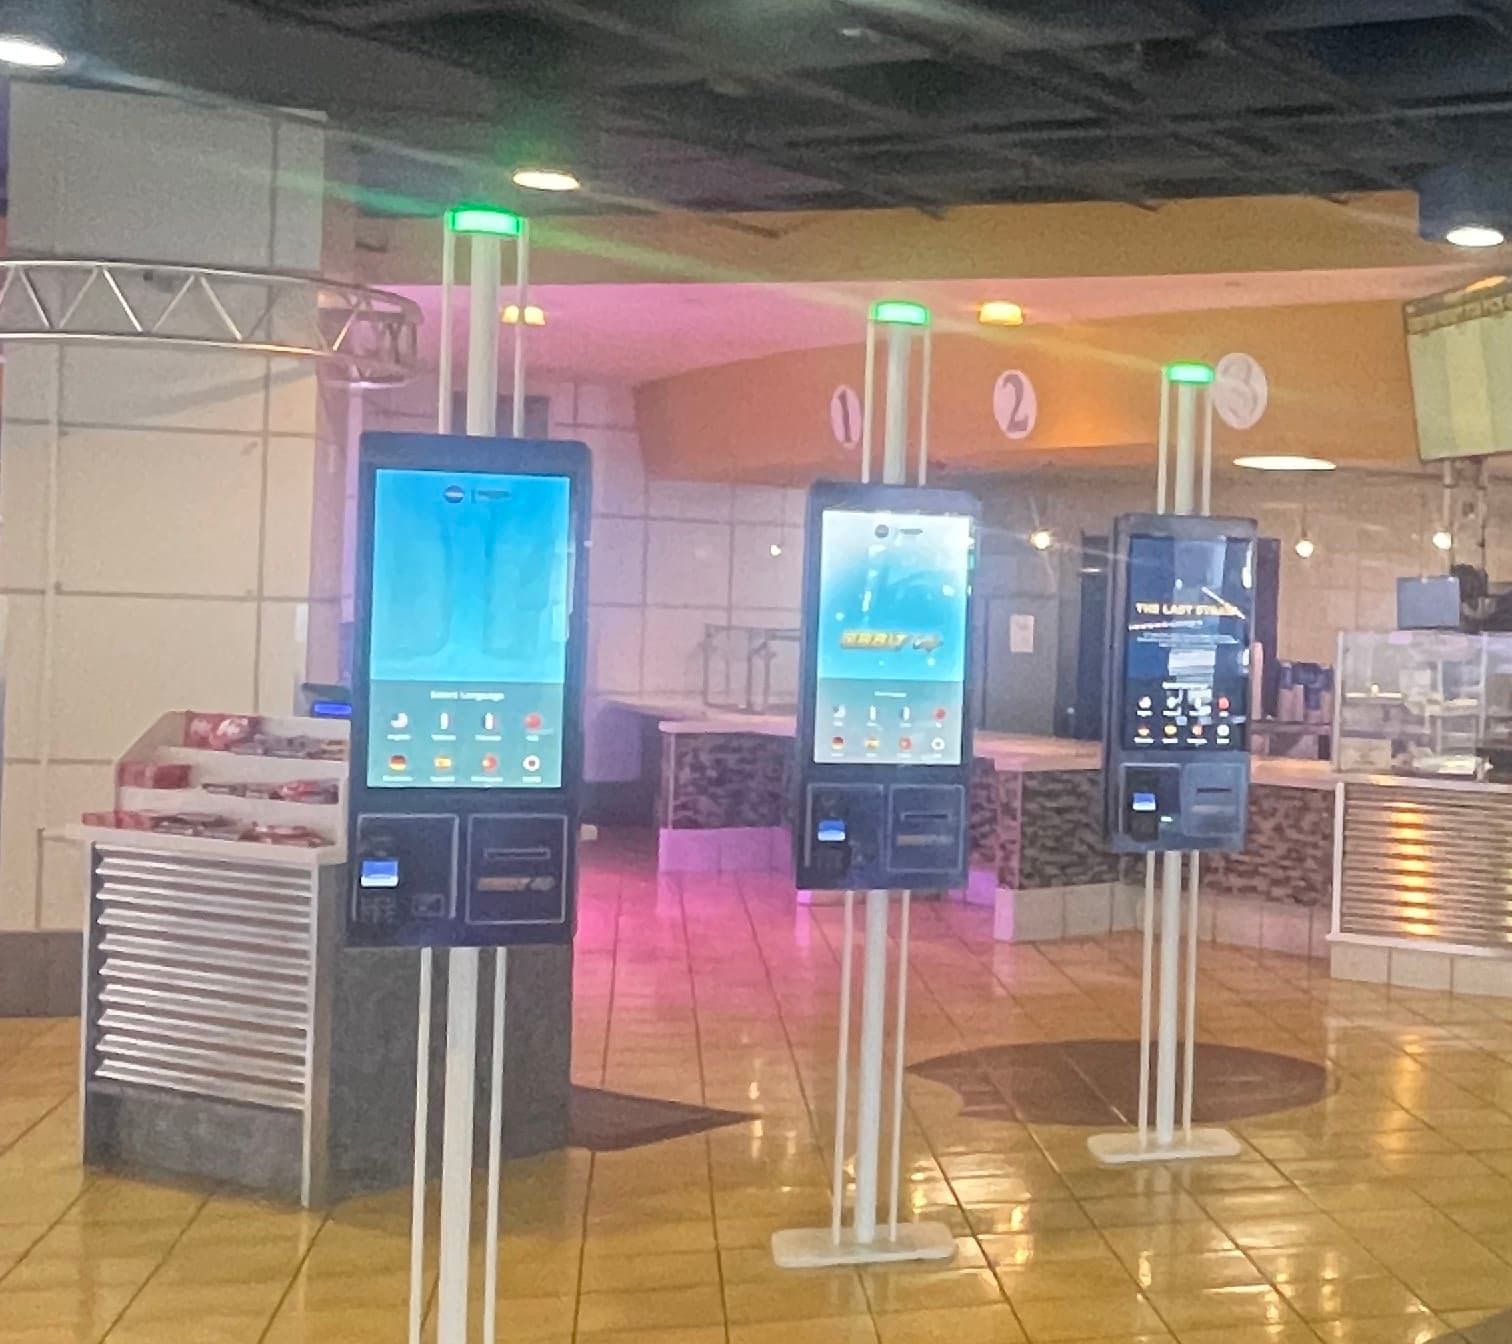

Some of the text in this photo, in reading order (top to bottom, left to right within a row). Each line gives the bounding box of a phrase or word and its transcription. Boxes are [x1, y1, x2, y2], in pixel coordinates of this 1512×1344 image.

[839, 389, 853, 444] 1
[1000, 373, 1029, 433] 2
[1222, 359, 1259, 420] 3
